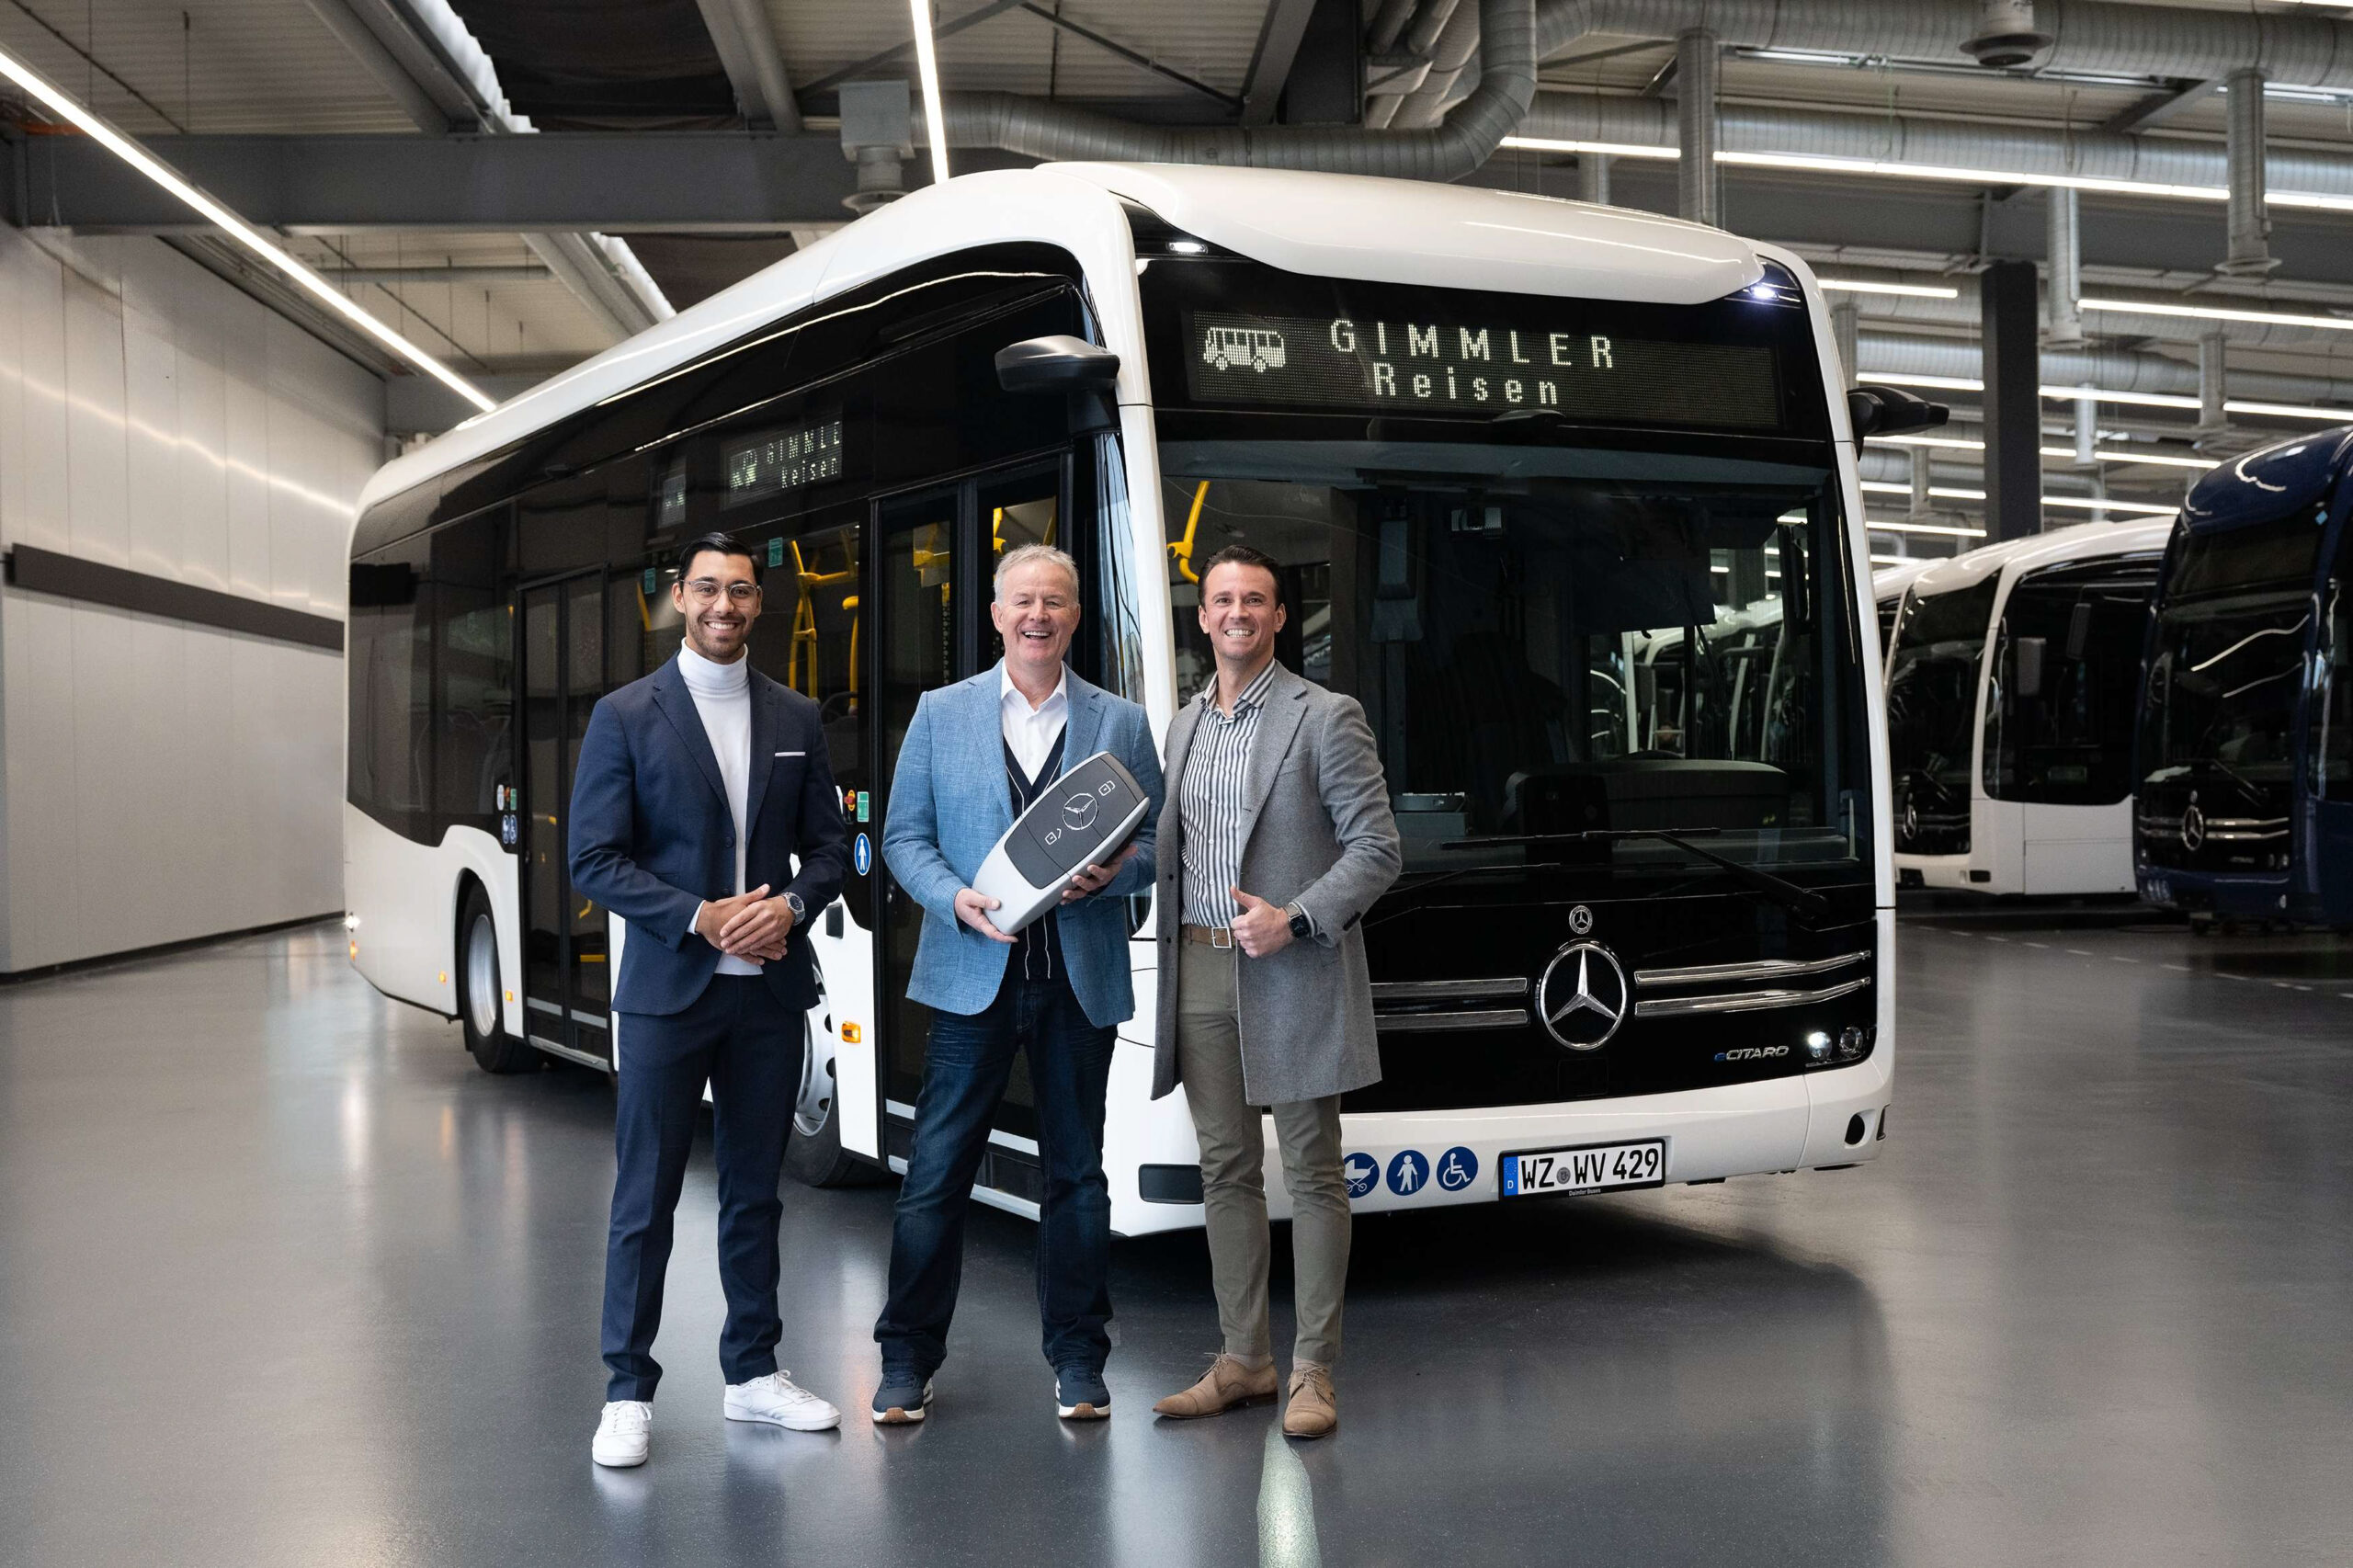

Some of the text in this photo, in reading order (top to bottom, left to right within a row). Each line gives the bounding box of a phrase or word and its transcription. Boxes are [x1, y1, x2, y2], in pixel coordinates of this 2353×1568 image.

[1330, 319, 1613, 369] GIMMLER
[1373, 362, 1558, 405] Reisen
[1507, 1180, 1514, 1189] D
[1521, 1148, 1659, 1189] WZ WV 429
